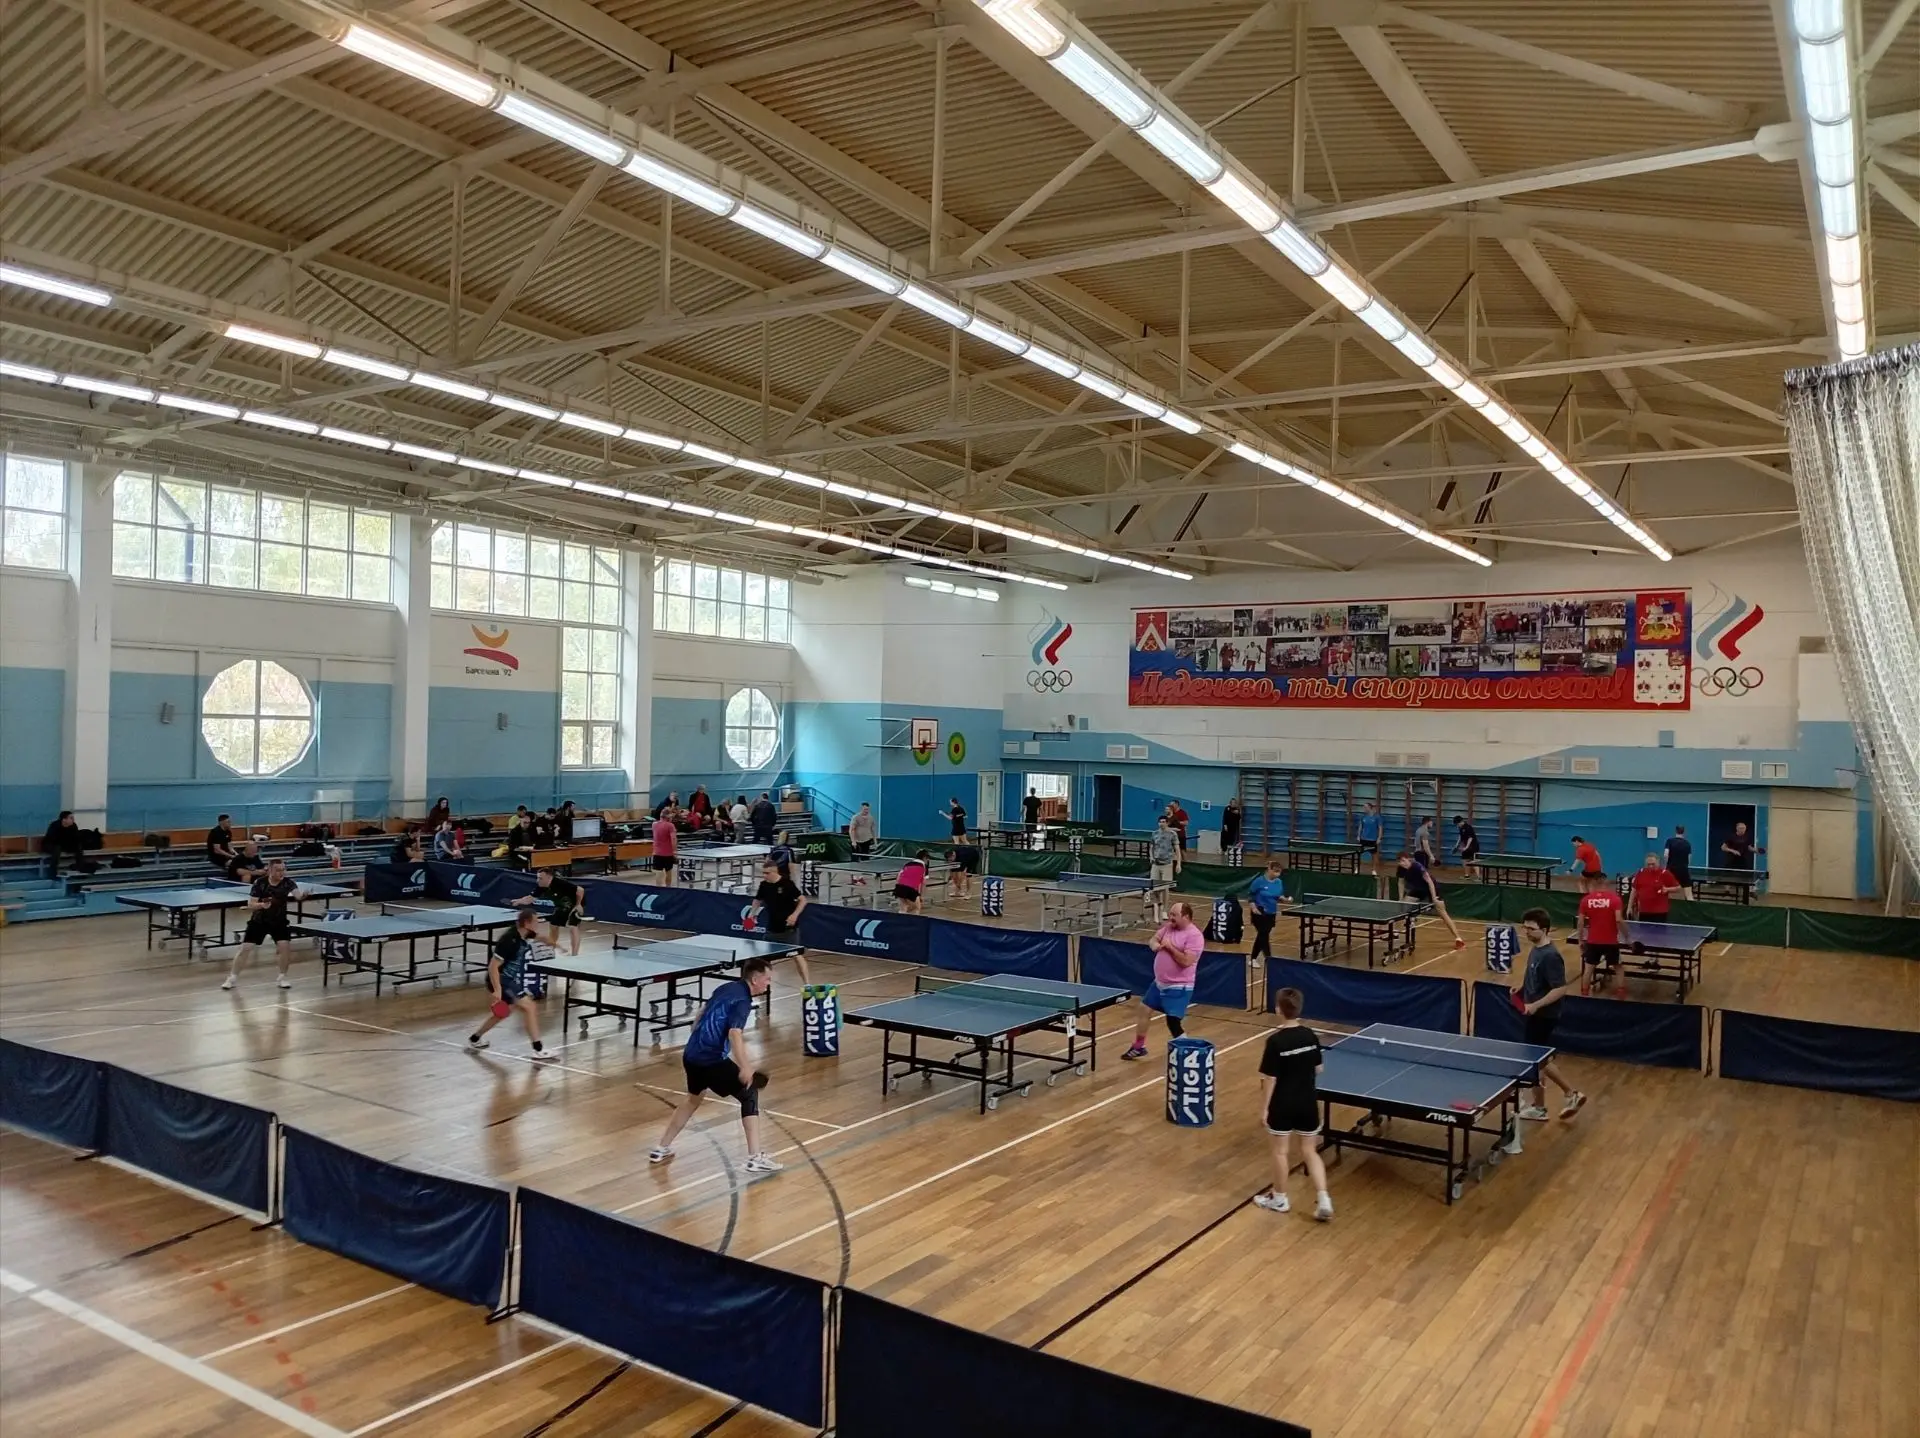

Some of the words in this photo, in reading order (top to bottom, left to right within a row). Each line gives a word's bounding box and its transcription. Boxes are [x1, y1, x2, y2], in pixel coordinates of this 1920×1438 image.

[1134, 670, 1281, 703] Деденево,
[1288, 678, 1347, 699] ты
[1353, 678, 1490, 707] спорта
[1496, 668, 1628, 700] океан!
[990, 880, 998, 915] STIGA
[1588, 898, 1610, 908] FCSM
[1488, 928, 1496, 970] STIGA
[1499, 928, 1510, 973] STIGA
[806, 996, 819, 1053] STIGA
[824, 991, 836, 1051] STIGA
[1168, 1048, 1178, 1120] STIGA
[1183, 1050, 1200, 1123] STIGA
[1204, 1049, 1214, 1120] STIGA
[1425, 1112, 1457, 1124] STIGA
